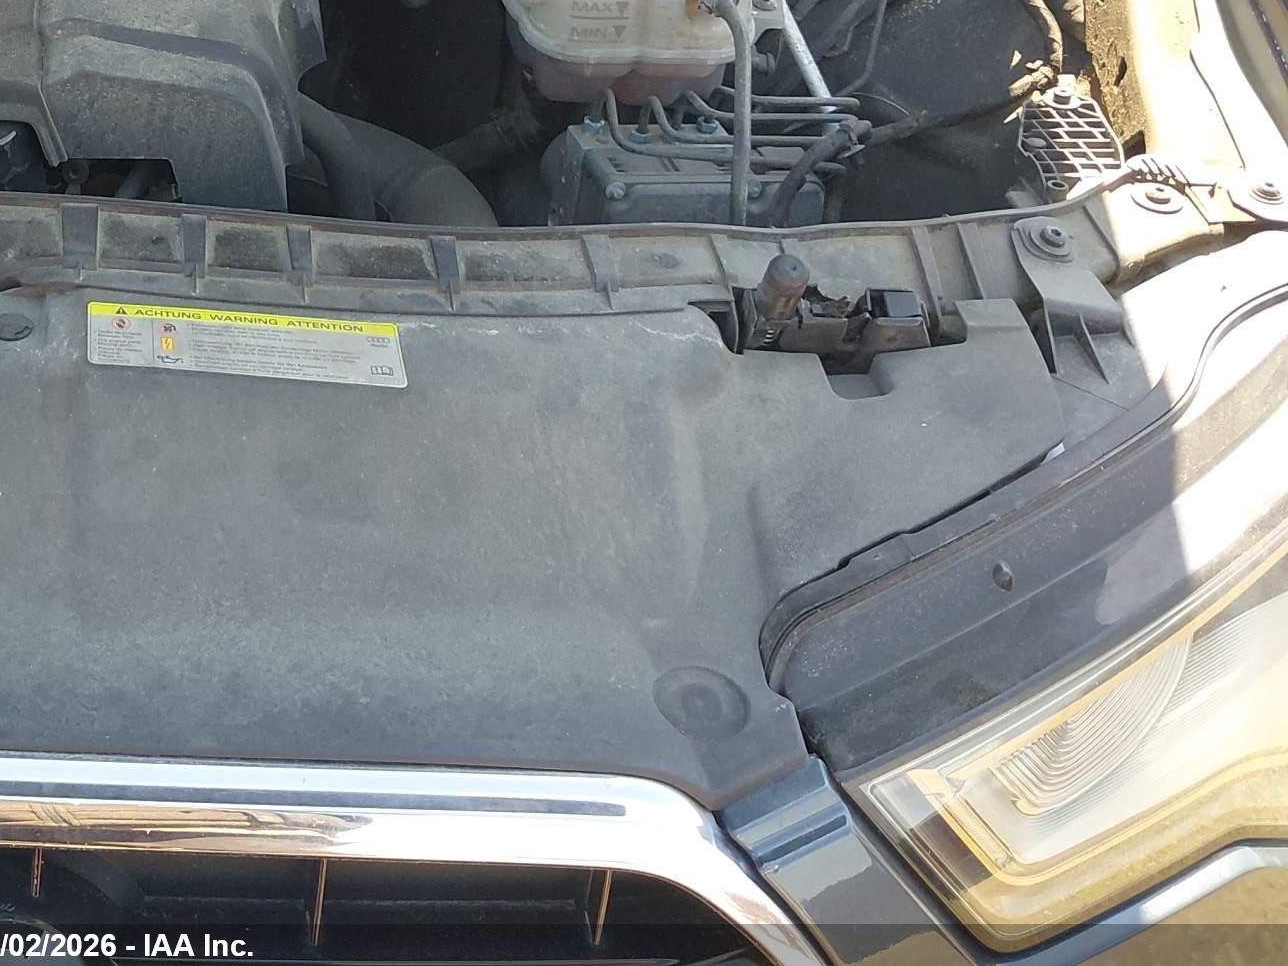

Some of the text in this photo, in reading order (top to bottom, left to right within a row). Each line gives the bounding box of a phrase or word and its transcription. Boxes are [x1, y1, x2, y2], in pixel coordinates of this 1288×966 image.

[571, 1, 614, 12] MAX
[134, 308, 364, 332] ACHTUNG WARNING ATTENTION
